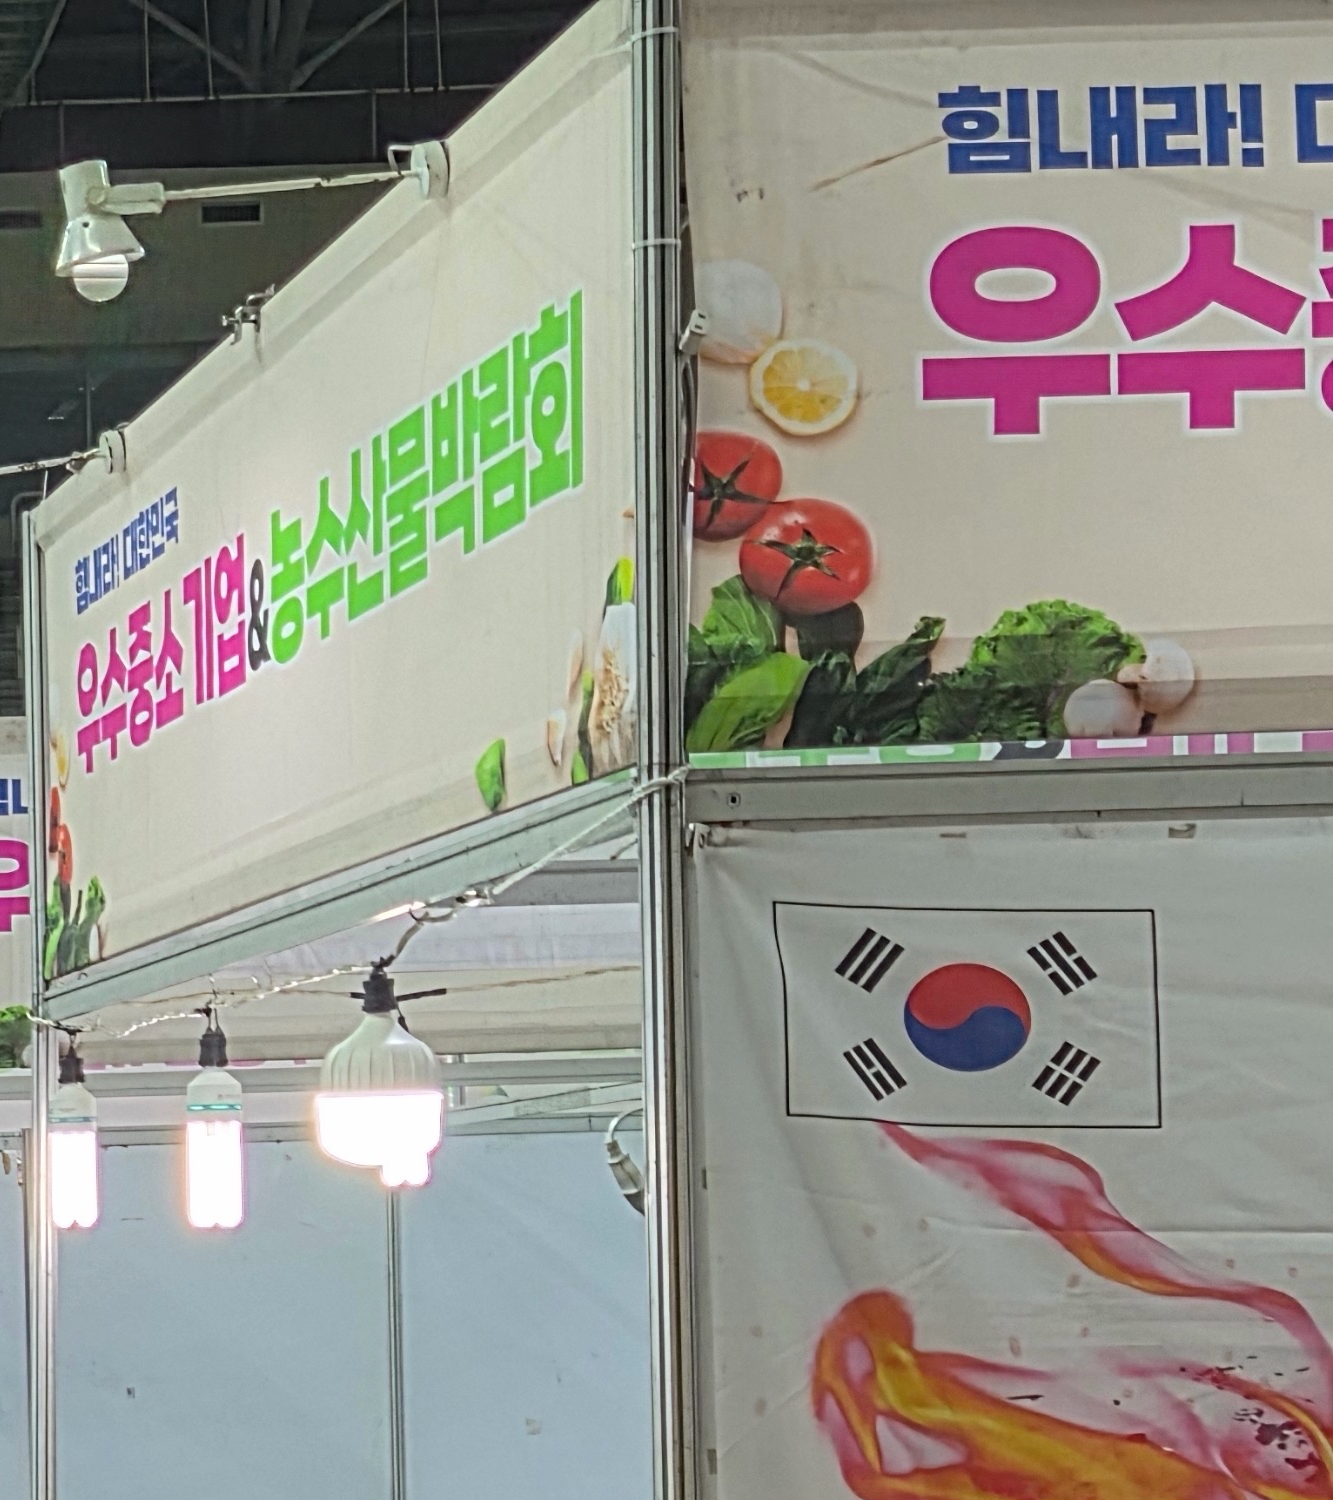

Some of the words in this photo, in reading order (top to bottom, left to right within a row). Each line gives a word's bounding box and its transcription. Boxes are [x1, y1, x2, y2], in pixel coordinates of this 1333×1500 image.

[937, 83, 1265, 175] 힘내라!
[921, 218, 1333, 436] 우수
[122, 486, 179, 581] 대한민국
